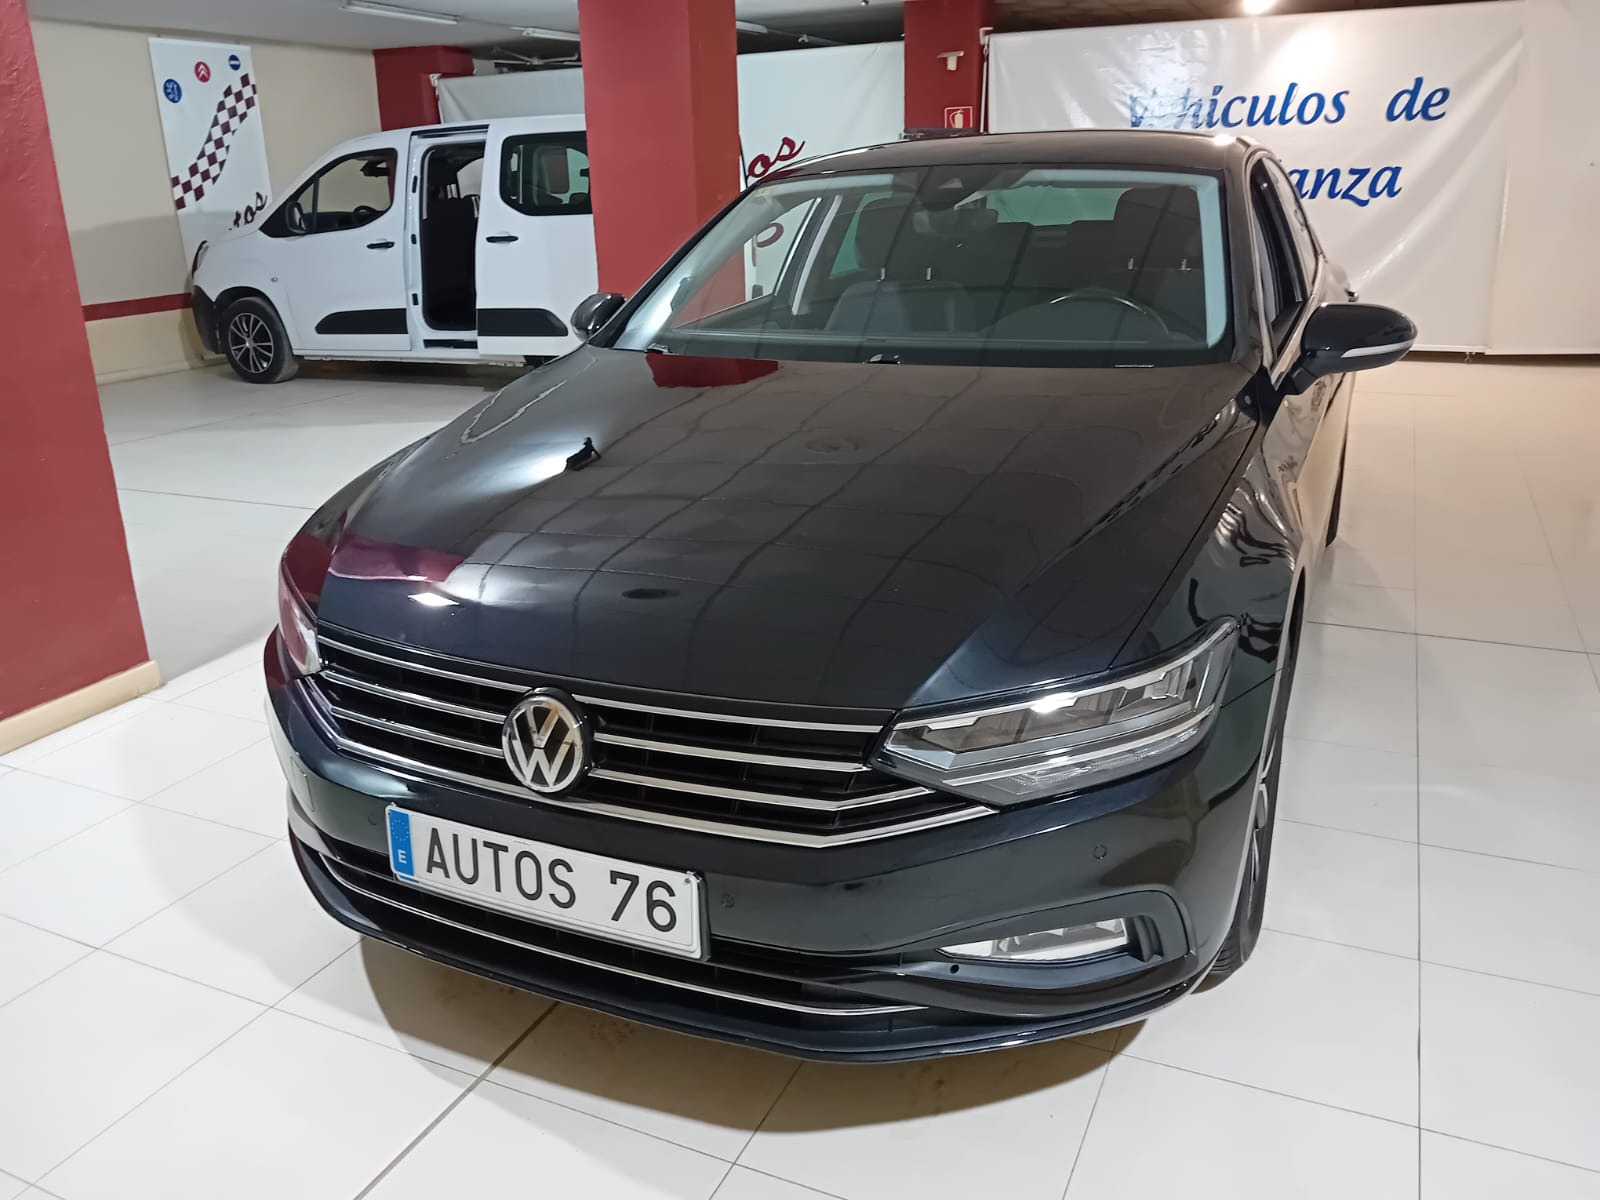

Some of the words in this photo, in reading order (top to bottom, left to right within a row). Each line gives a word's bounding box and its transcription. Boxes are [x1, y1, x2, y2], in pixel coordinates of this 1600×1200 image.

[1385, 76, 1451, 122] de
[1288, 165, 1402, 207] anza
[397, 849, 408, 864] E
[426, 827, 576, 909] AUTOS
[608, 869, 677, 932] 76
